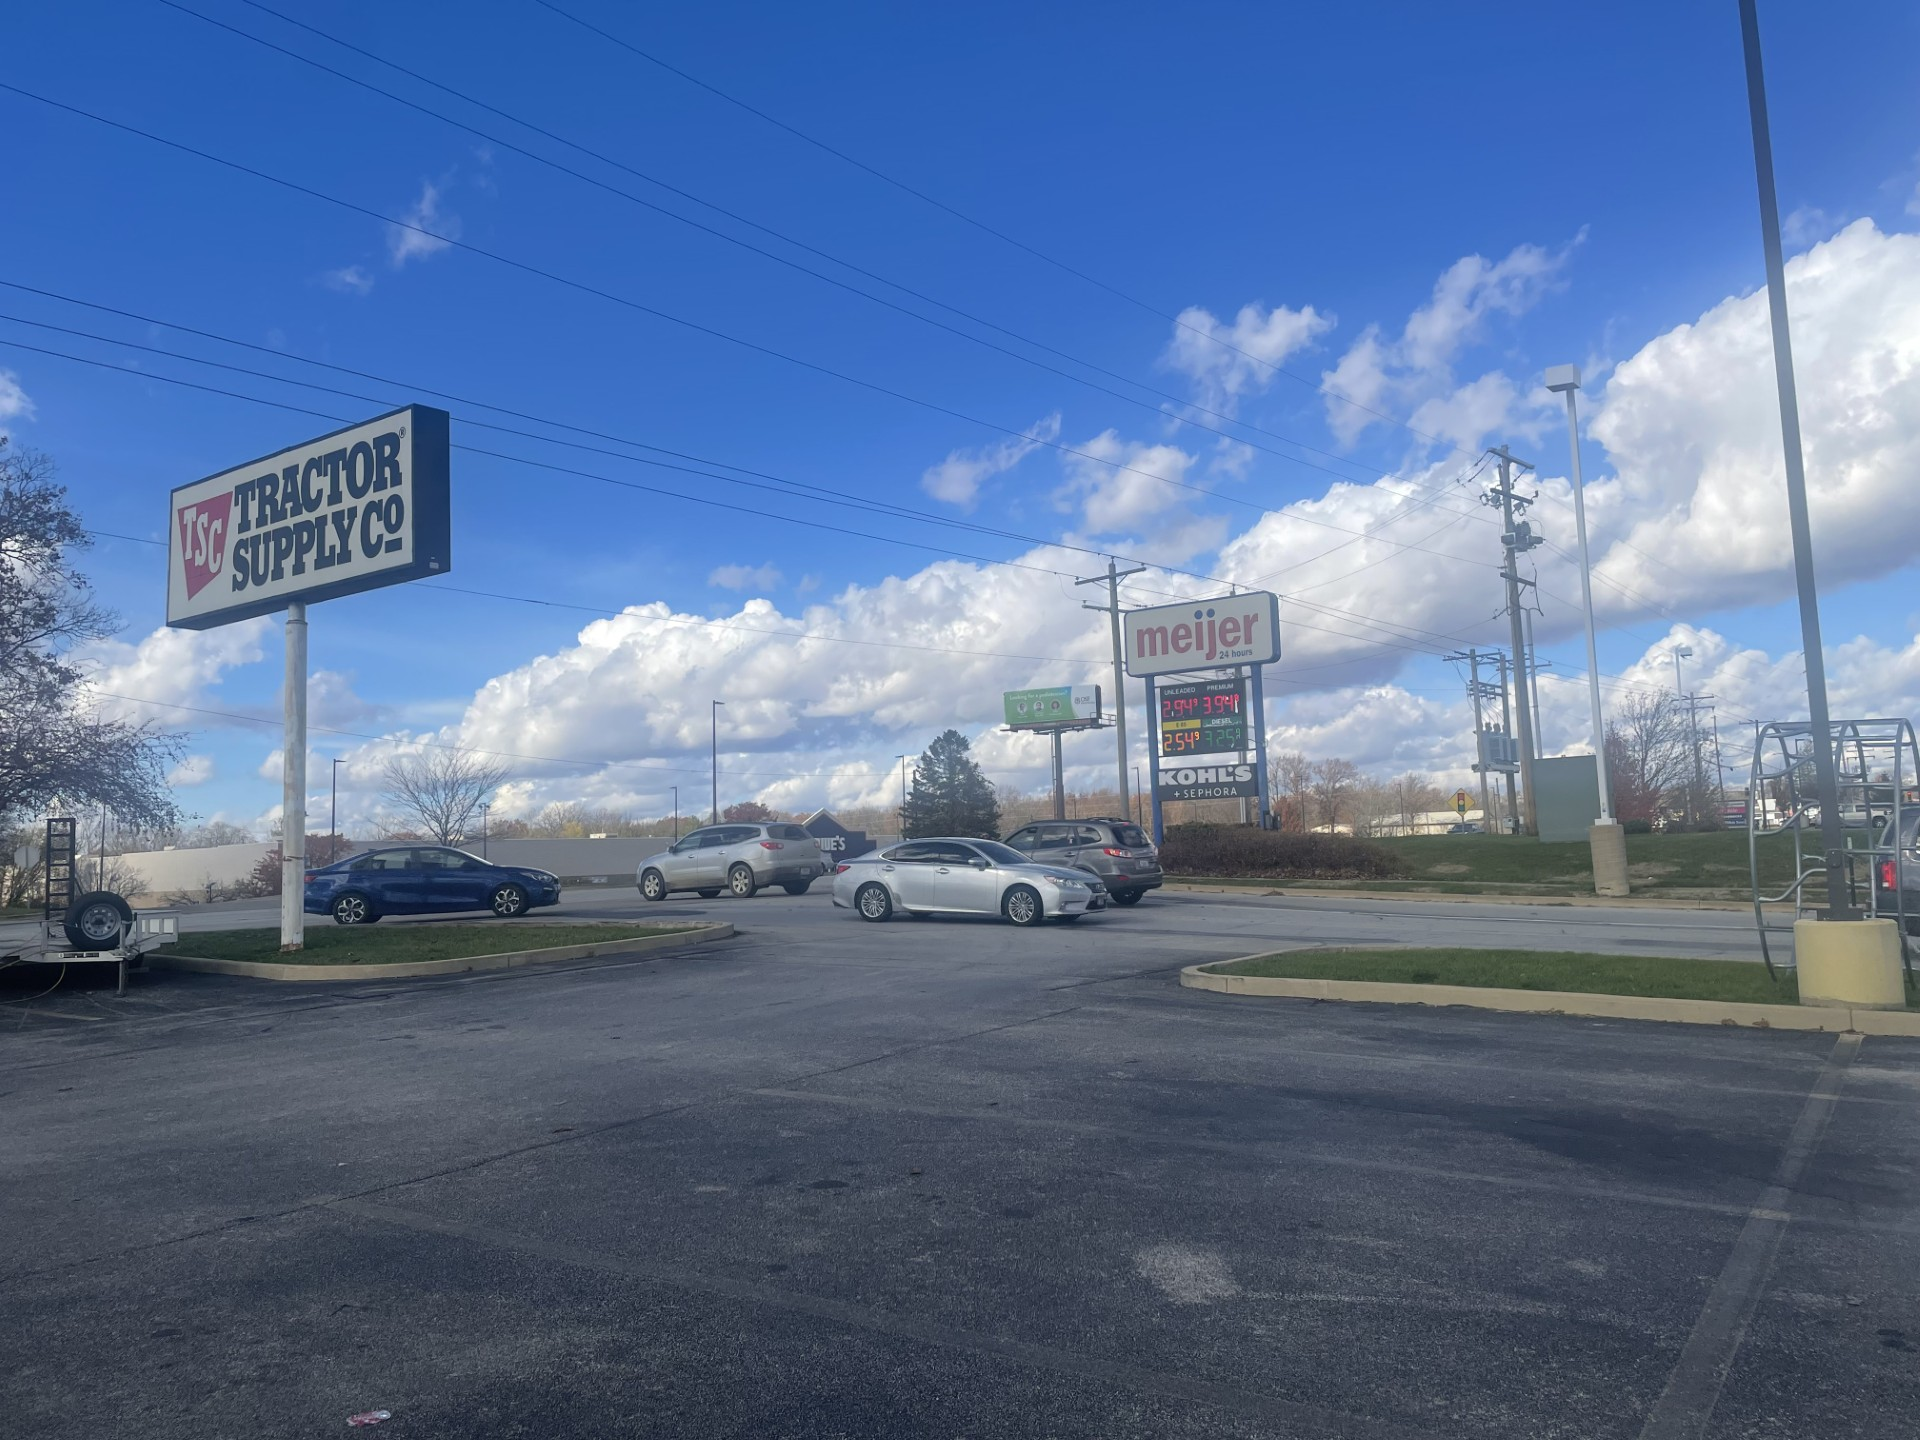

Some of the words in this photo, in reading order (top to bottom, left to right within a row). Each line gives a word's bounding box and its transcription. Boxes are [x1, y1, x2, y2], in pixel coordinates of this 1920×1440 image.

[234, 431, 402, 534] TRACTOR
[183, 506, 223, 574] TSC
[232, 506, 358, 592] SUPPLY
[1136, 608, 1259, 661] meijer
[1219, 650, 1229, 660] 24
[1231, 648, 1253, 658] hours
[1164, 687, 1196, 696] UNLEADED
[1206, 683, 1234, 691] PREMIUM
[1211, 717, 1233, 725] DIESEL
[1158, 765, 1252, 786] KOHL'S
[1183, 786, 1238, 798] SEPHORA
